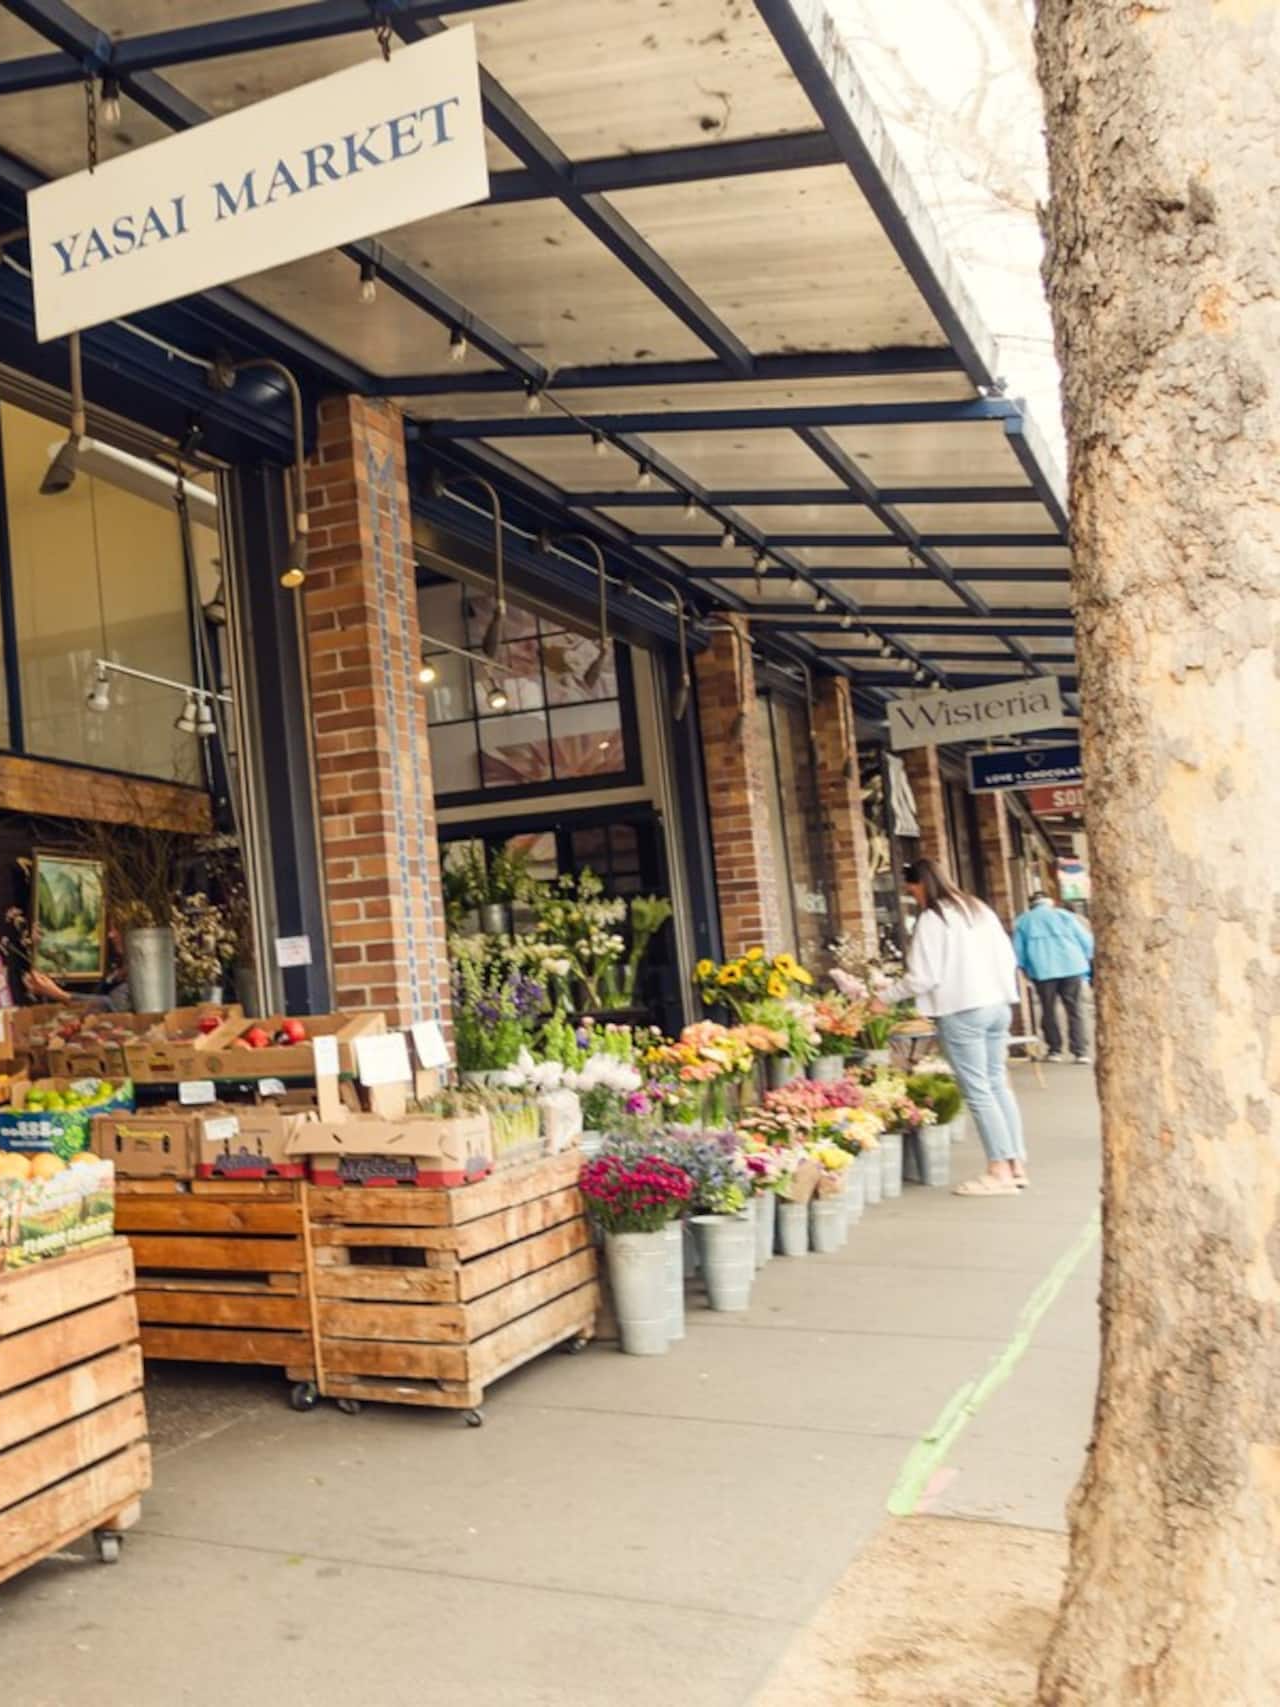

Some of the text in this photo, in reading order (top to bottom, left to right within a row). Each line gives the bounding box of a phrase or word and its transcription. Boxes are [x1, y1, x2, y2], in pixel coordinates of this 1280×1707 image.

[50, 96, 460, 277] YASAI MARKET
[896, 688, 1051, 731] Wisteria
